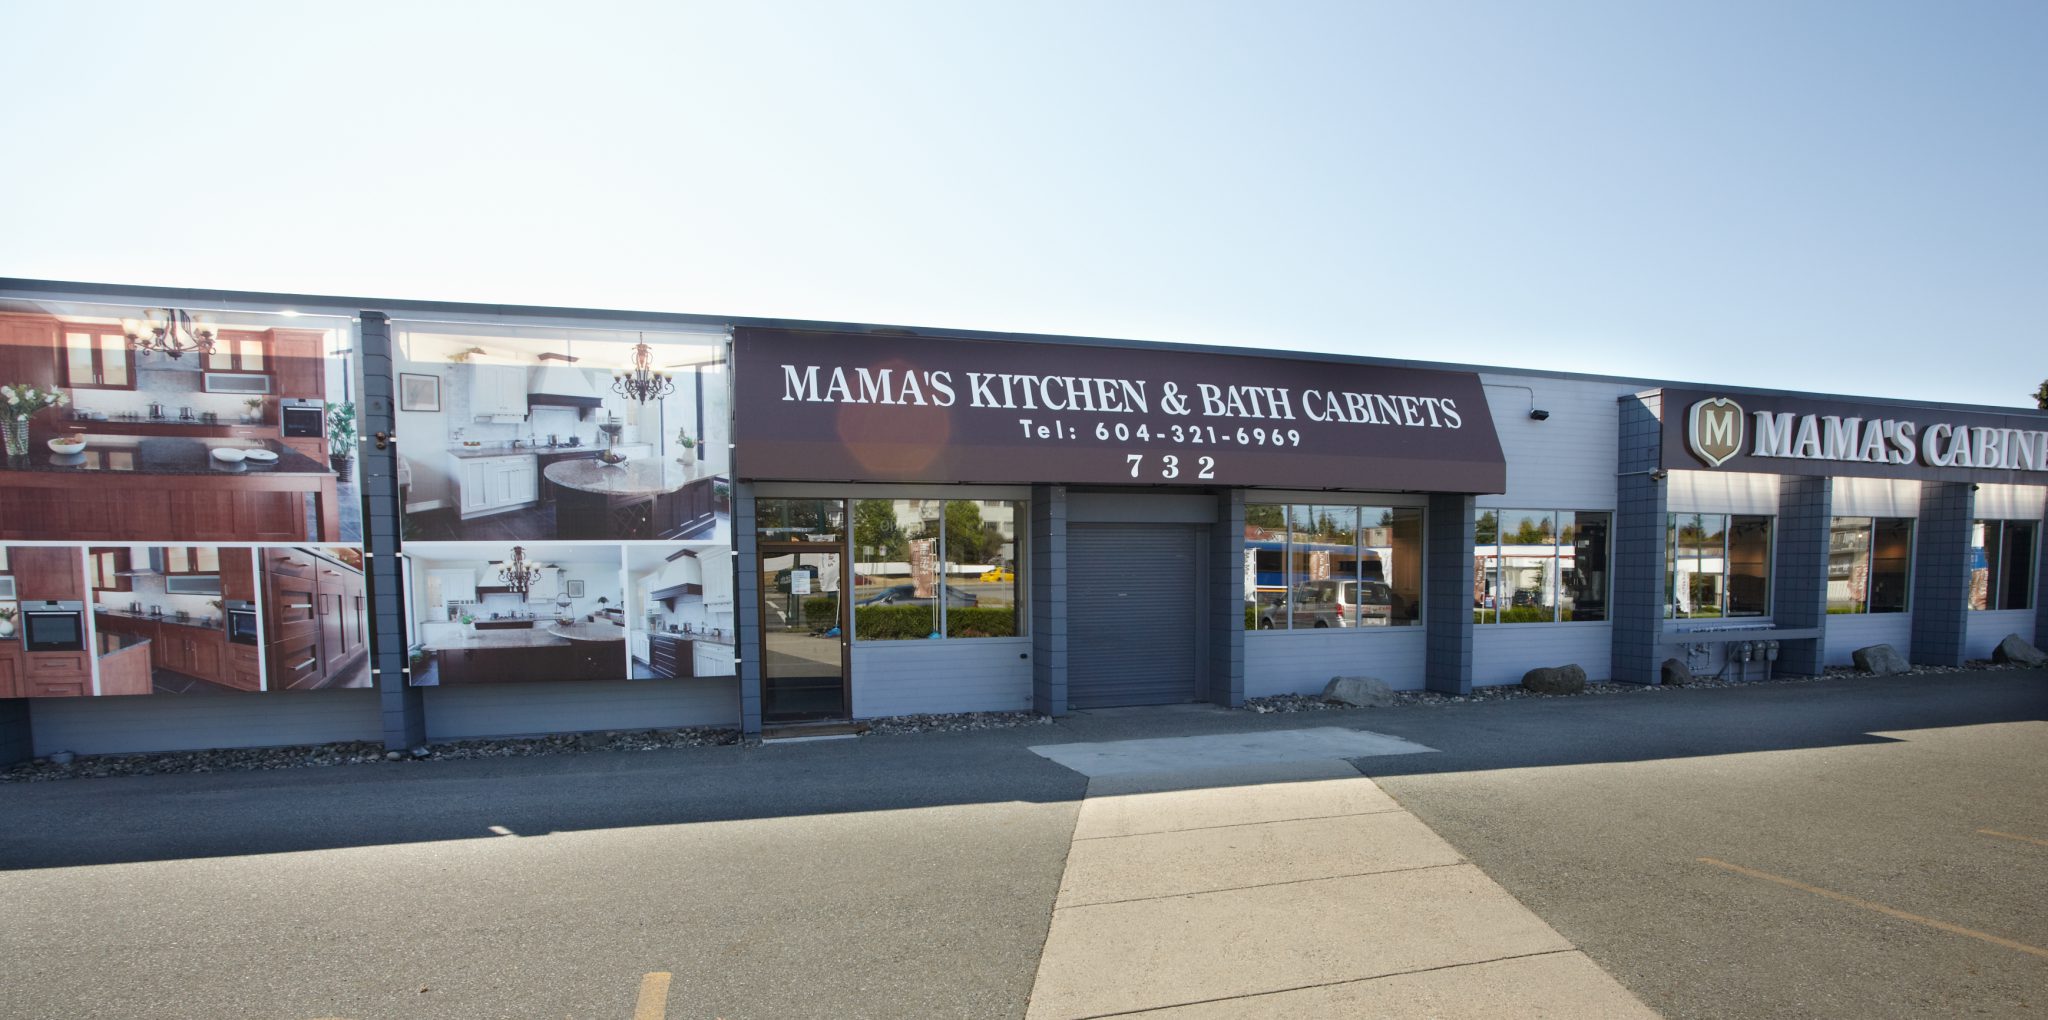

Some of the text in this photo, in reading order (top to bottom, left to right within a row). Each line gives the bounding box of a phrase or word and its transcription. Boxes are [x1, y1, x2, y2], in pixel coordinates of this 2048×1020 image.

[781, 364, 1462, 429] MAMA'S KITCHEN & BATH CABINETS
[1019, 418, 1300, 447] Tel: 604-321-6969
[1705, 410, 1734, 447] M
[1750, 410, 1916, 465] MAMA'S
